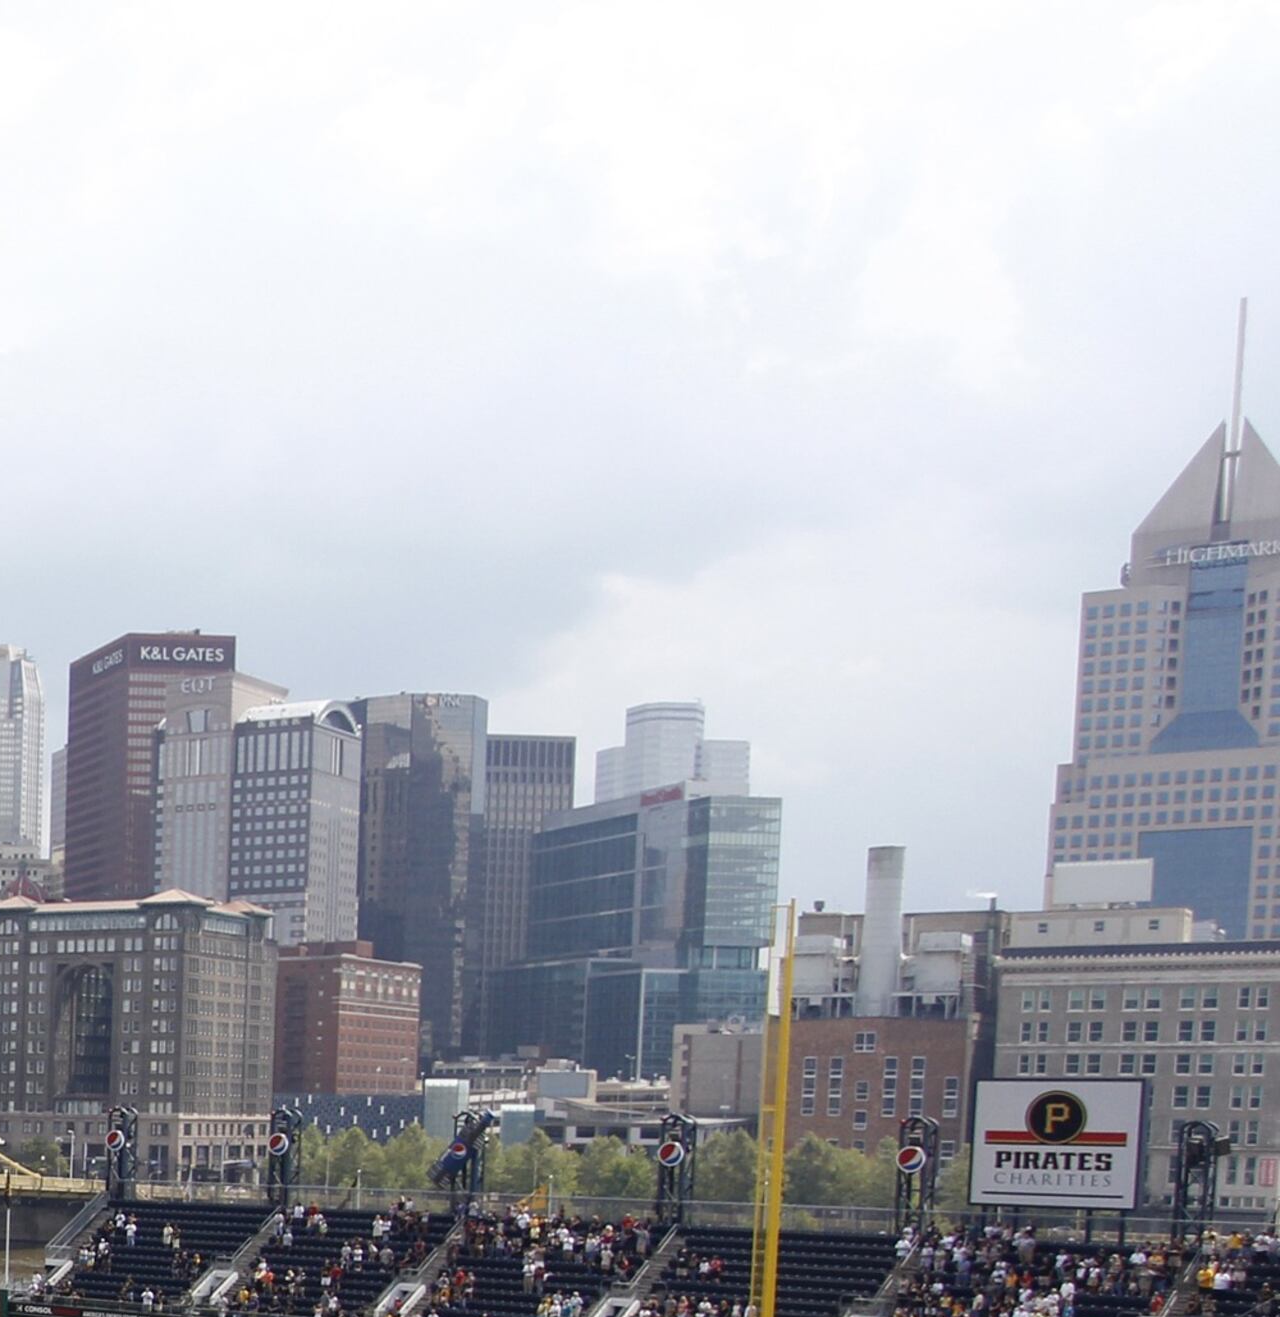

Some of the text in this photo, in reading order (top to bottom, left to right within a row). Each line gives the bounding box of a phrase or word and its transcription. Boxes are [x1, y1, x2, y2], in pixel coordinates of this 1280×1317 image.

[140, 646, 225, 662] K&L GATES
[1043, 1102, 1070, 1134] P
[994, 1150, 1113, 1171] PIRATES
[993, 1172, 1112, 1188] CHARITIES
[24, 1306, 52, 1315] CONSOL
